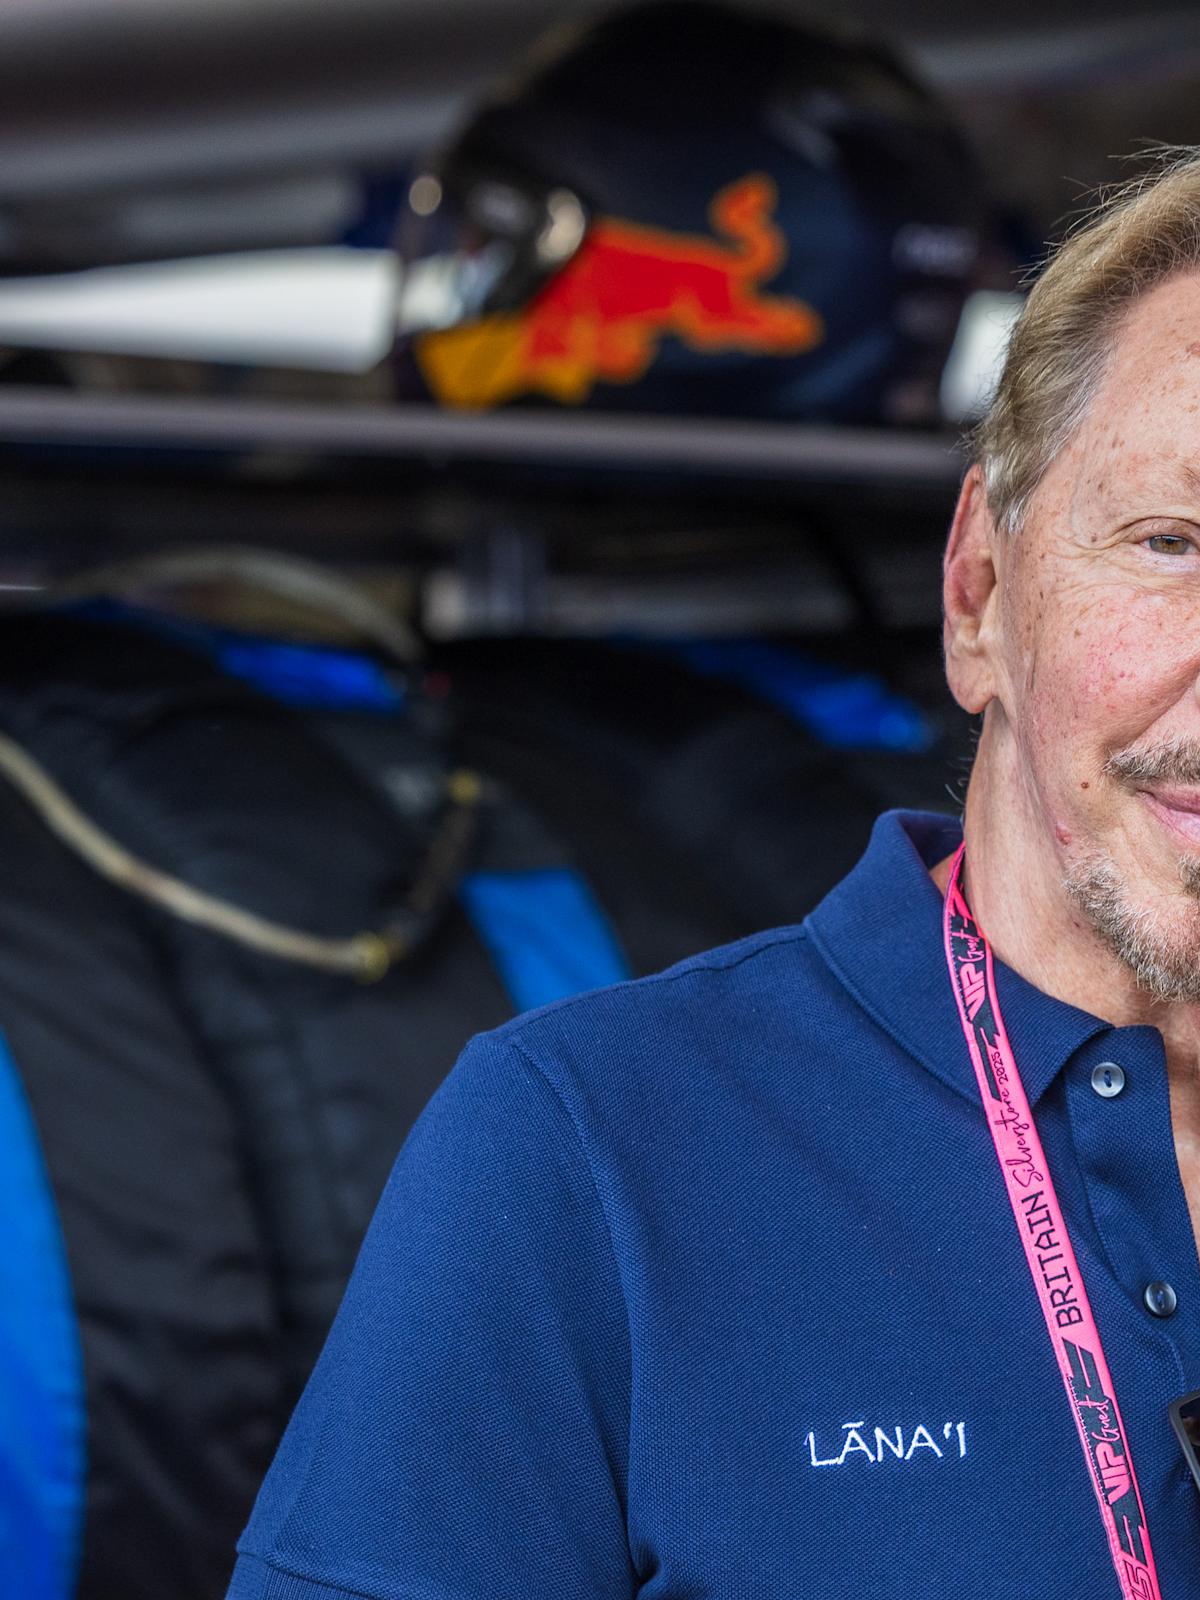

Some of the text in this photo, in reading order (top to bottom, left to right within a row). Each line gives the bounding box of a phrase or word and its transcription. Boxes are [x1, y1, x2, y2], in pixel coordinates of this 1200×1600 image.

[960, 963, 986, 1020] VIP
[991, 1051, 1083, 1328] BRITAIN Silverstone 2025
[1078, 1395, 1131, 1505] VIP Guest
